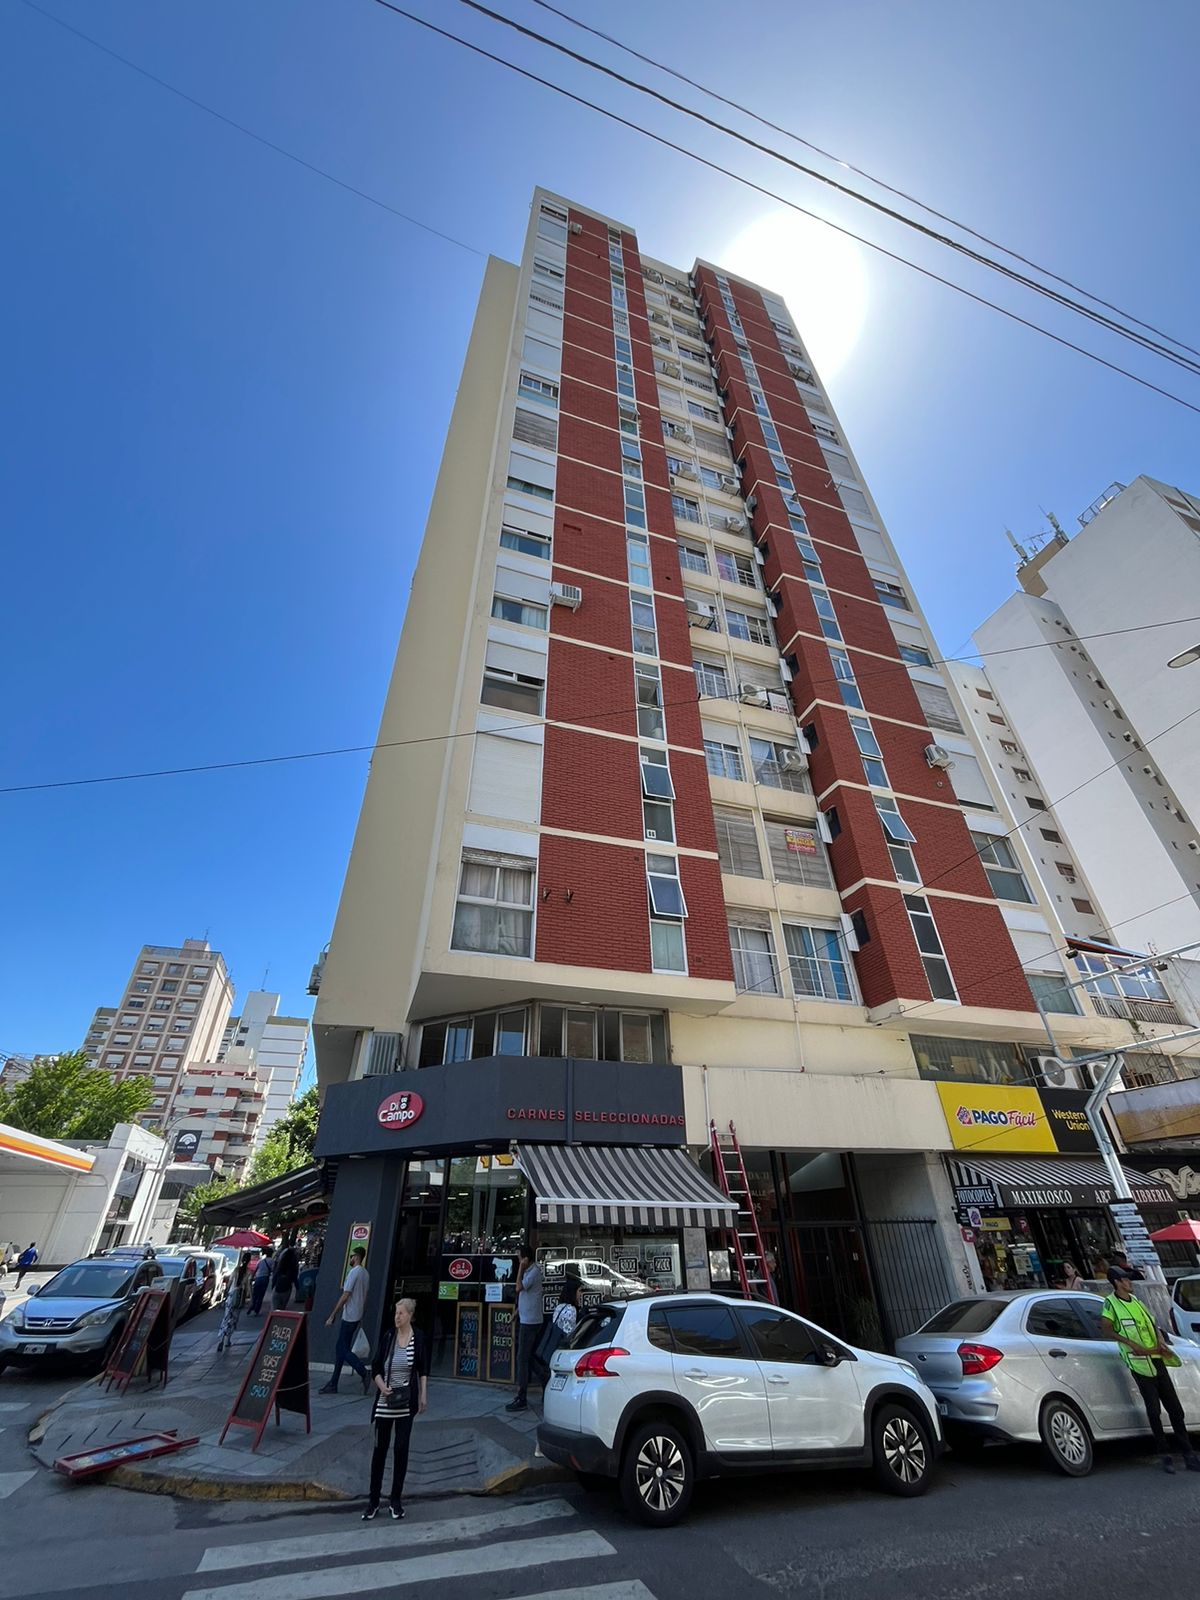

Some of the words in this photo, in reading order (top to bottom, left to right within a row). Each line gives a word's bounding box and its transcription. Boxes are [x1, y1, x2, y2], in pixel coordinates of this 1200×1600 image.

[389, 1101, 399, 1111] Di
[378, 1110, 415, 1123] Campo
[507, 1108, 566, 1121] CARNES
[575, 1110, 685, 1126] SELECCIONADAS
[1051, 1109, 1087, 1120] Western
[1066, 1119, 1090, 1131] Union
[1011, 1189, 1073, 1204] MAXIKIOSCO
[1132, 1189, 1173, 1202] LIBRERIA
[494, 1311, 513, 1324] LOMO
[271, 1324, 292, 1342] PALETA
